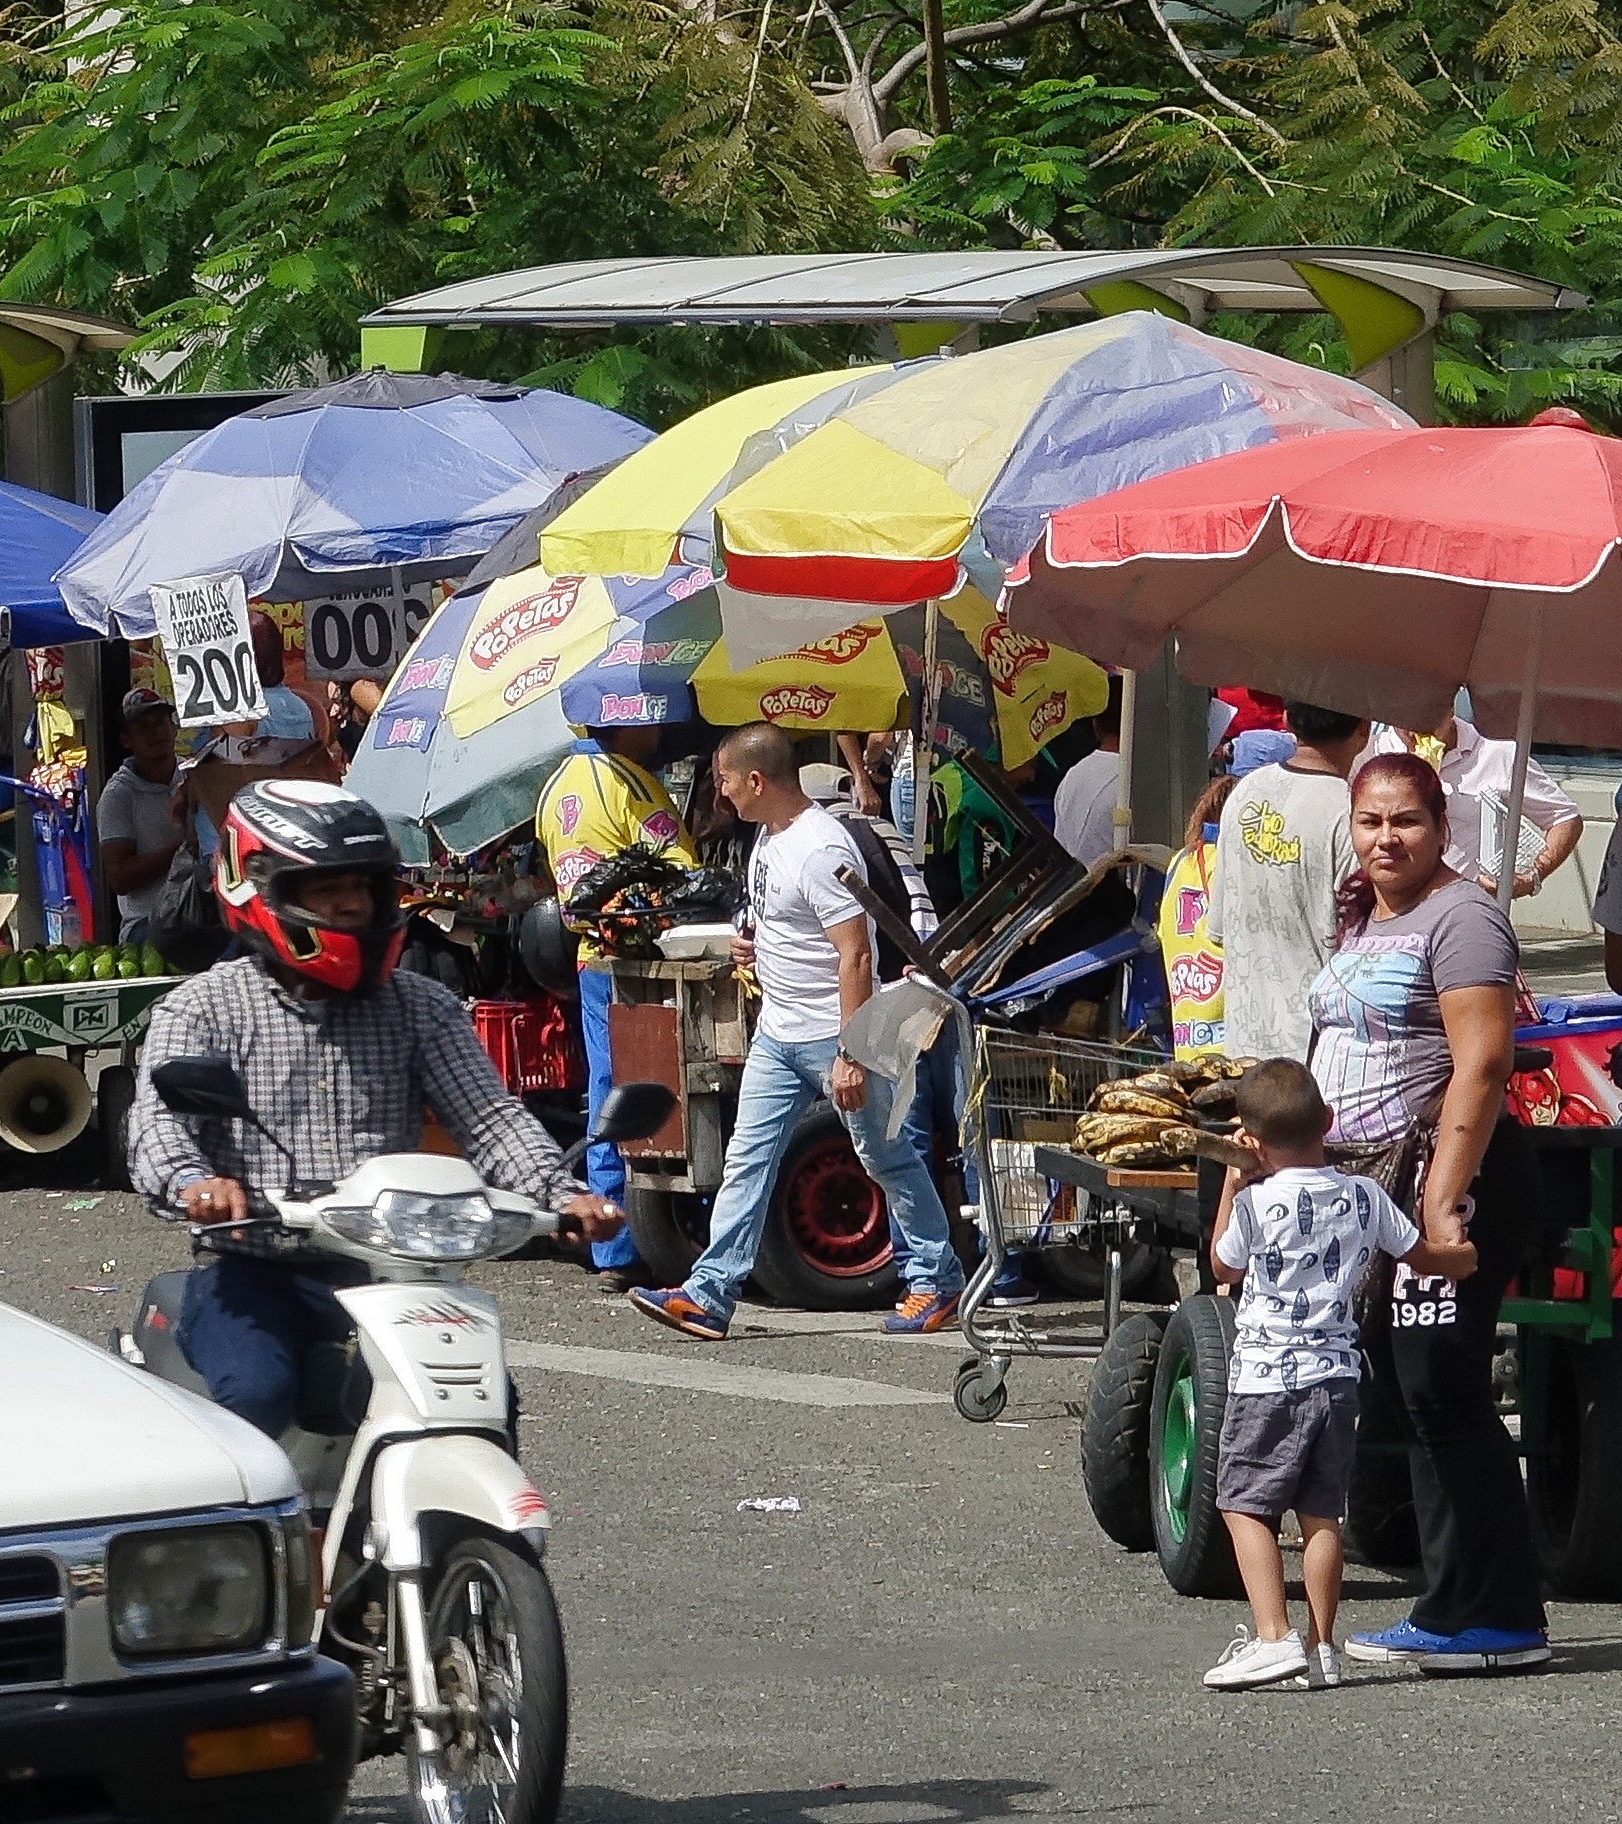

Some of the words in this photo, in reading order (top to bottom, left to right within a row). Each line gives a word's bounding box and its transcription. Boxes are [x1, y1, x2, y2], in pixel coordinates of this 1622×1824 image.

[168, 592, 178, 620] A
[178, 587, 209, 619] TODOS
[206, 583, 229, 613] LOS
[171, 609, 240, 649] OPERADORES
[177, 641, 259, 719] 200
[1391, 1300, 1458, 1328] 1982
